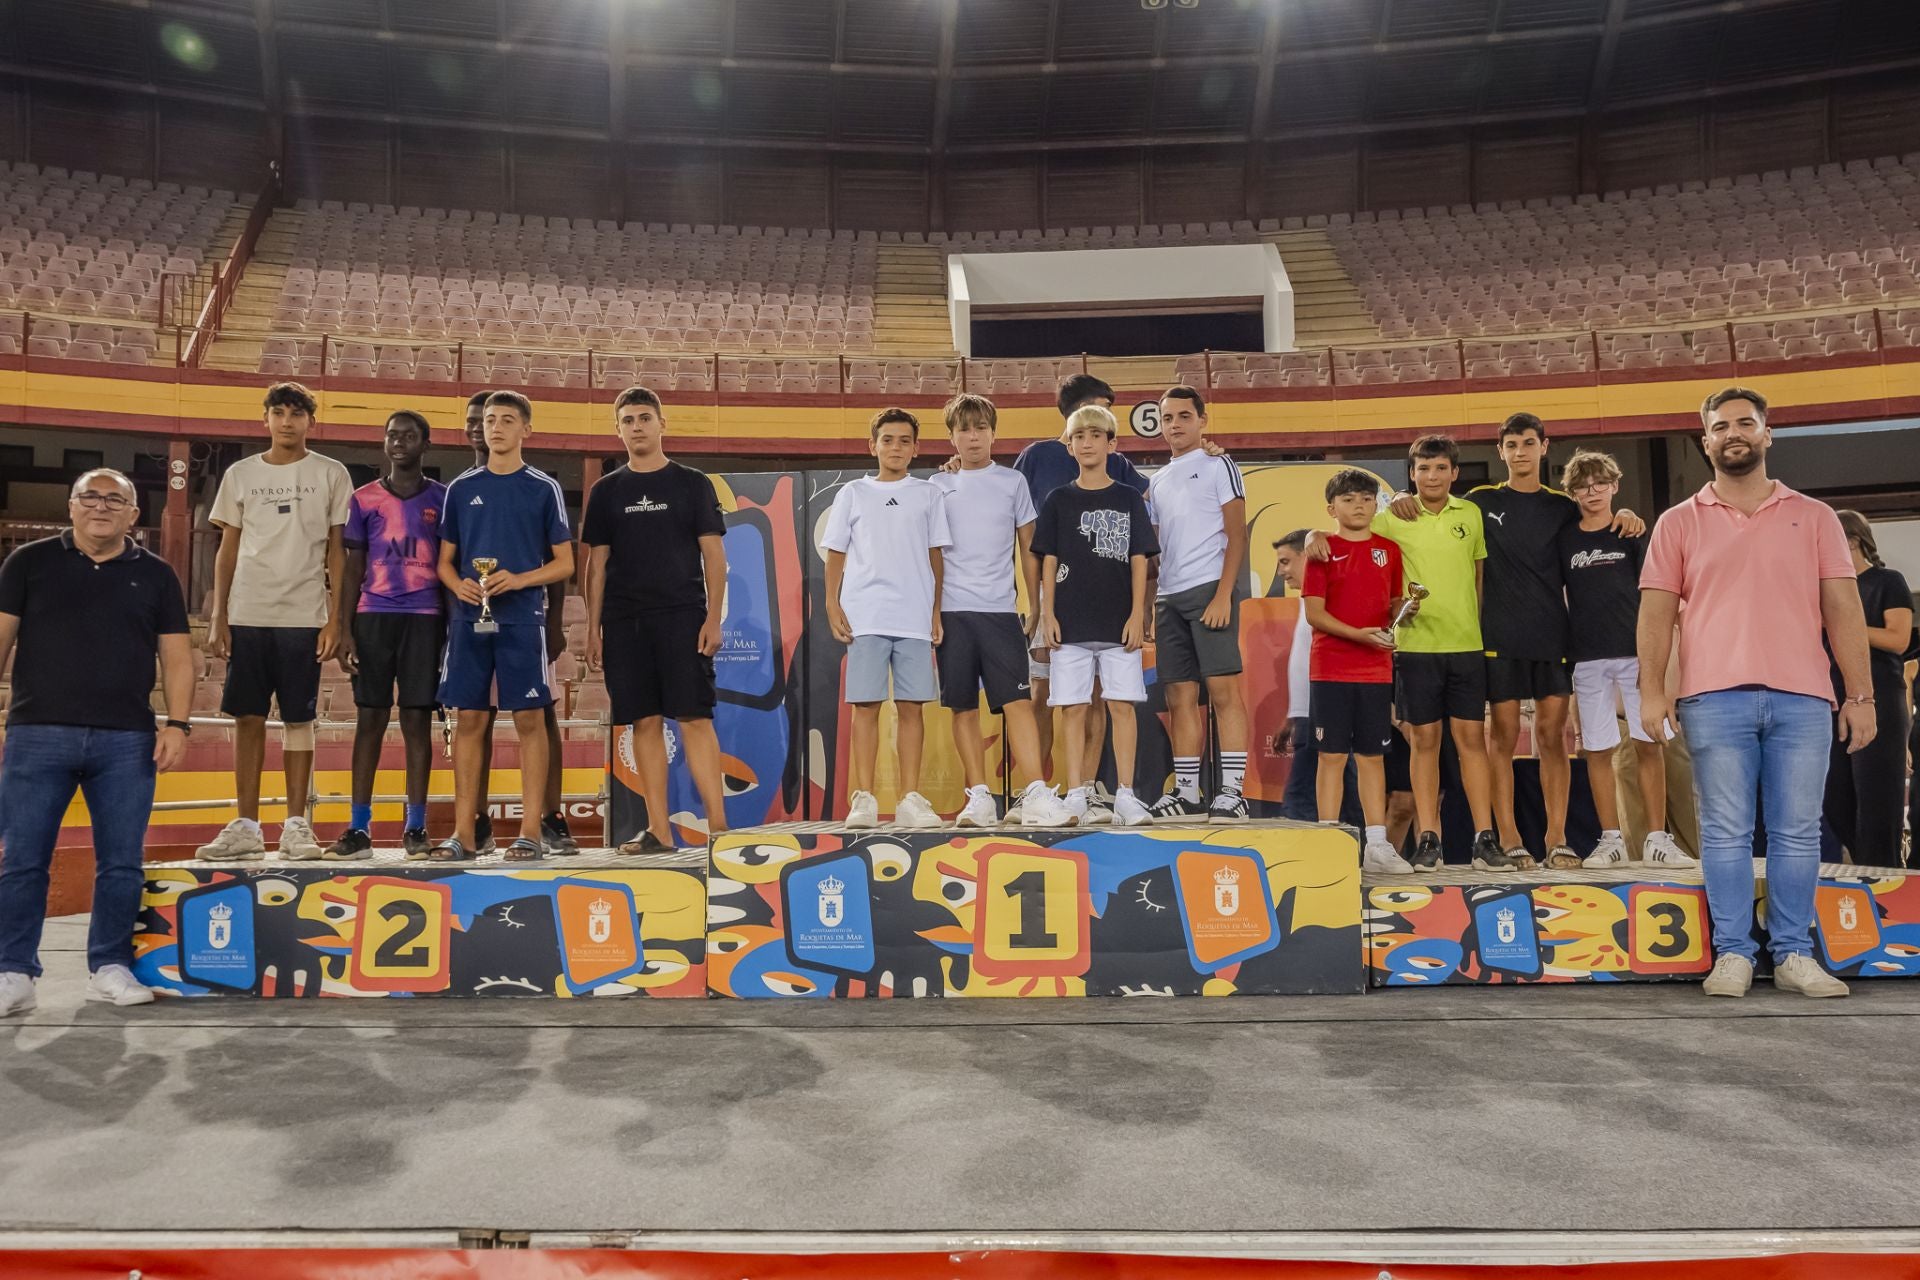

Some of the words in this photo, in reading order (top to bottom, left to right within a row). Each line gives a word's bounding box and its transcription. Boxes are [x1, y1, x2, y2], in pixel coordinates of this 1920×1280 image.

[1142, 408, 1158, 432] 5
[251, 487, 293, 496] BYRON
[296, 485, 317, 493] BAY
[624, 505, 644, 514] STONE
[646, 503, 668, 512] ISLAND
[733, 638, 758, 649] MAR
[1003, 871, 1058, 948] 1
[375, 899, 429, 967] 2
[800, 933, 834, 941] ROQUETAS
[847, 933, 863, 941] MAR
[1646, 902, 1690, 958] 3
